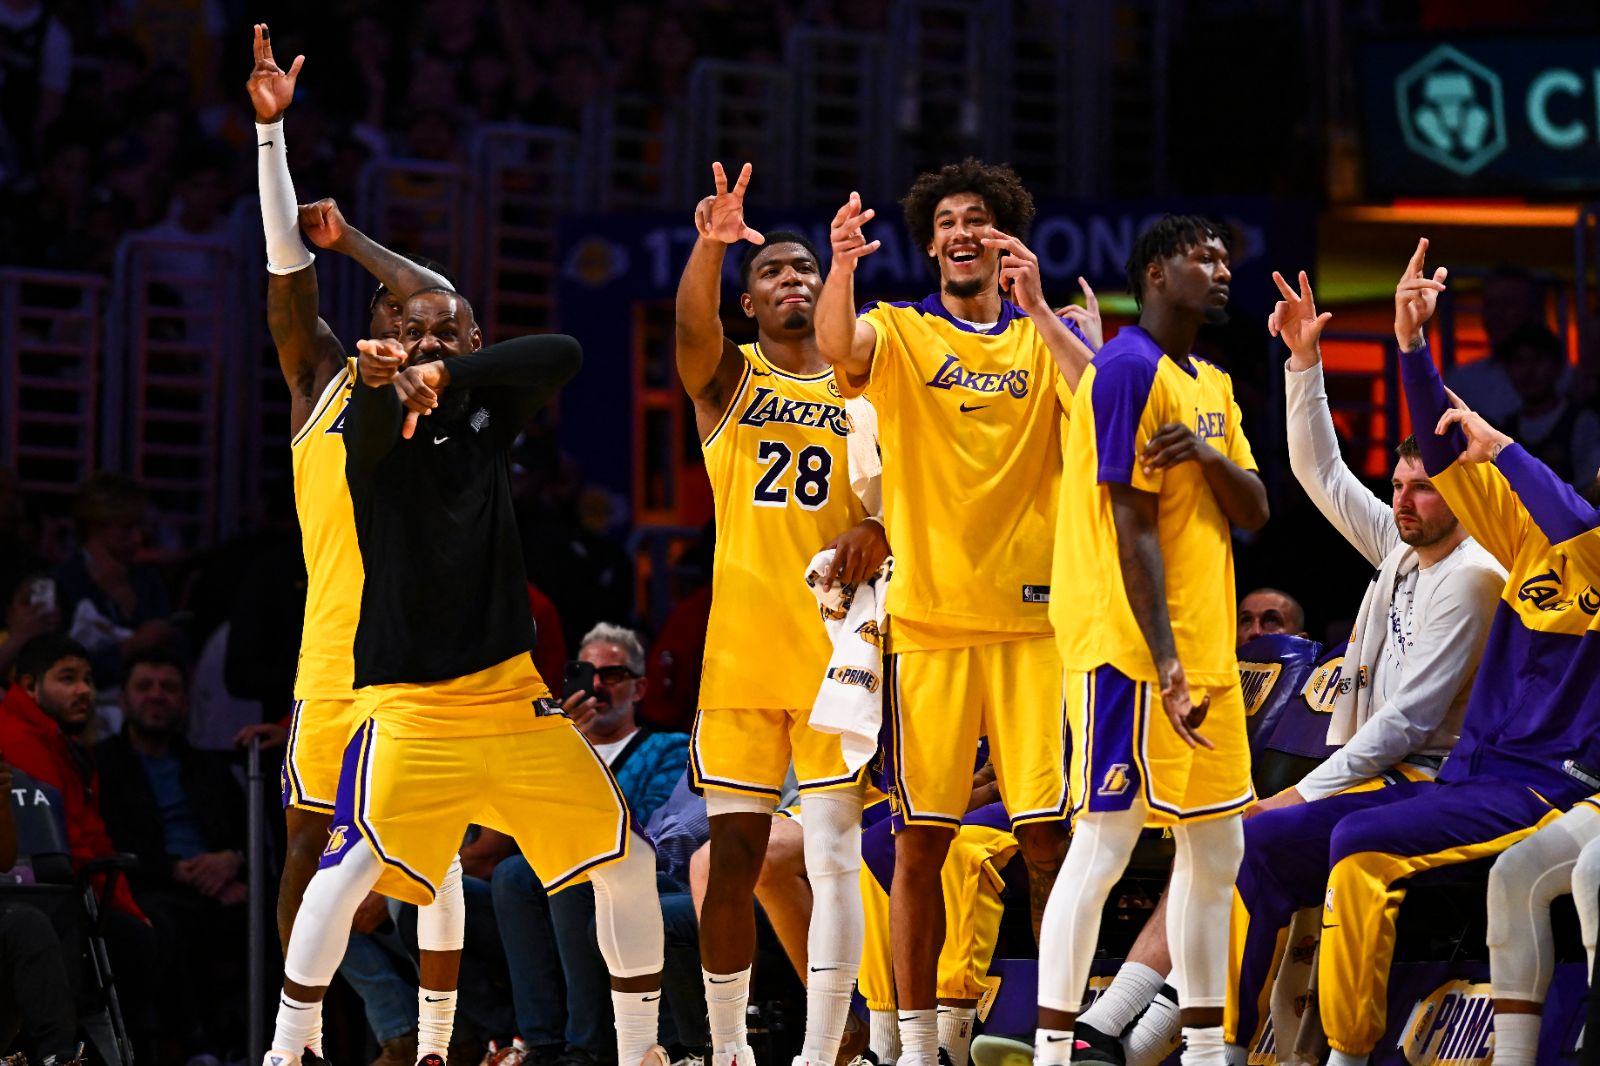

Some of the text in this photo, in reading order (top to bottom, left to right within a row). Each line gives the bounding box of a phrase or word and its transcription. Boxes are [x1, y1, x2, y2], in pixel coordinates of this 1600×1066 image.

[925, 353, 1030, 399] LAKERS
[752, 440, 834, 511] 28
[842, 668, 875, 689] PRIME
[10, 788, 50, 807] TA
